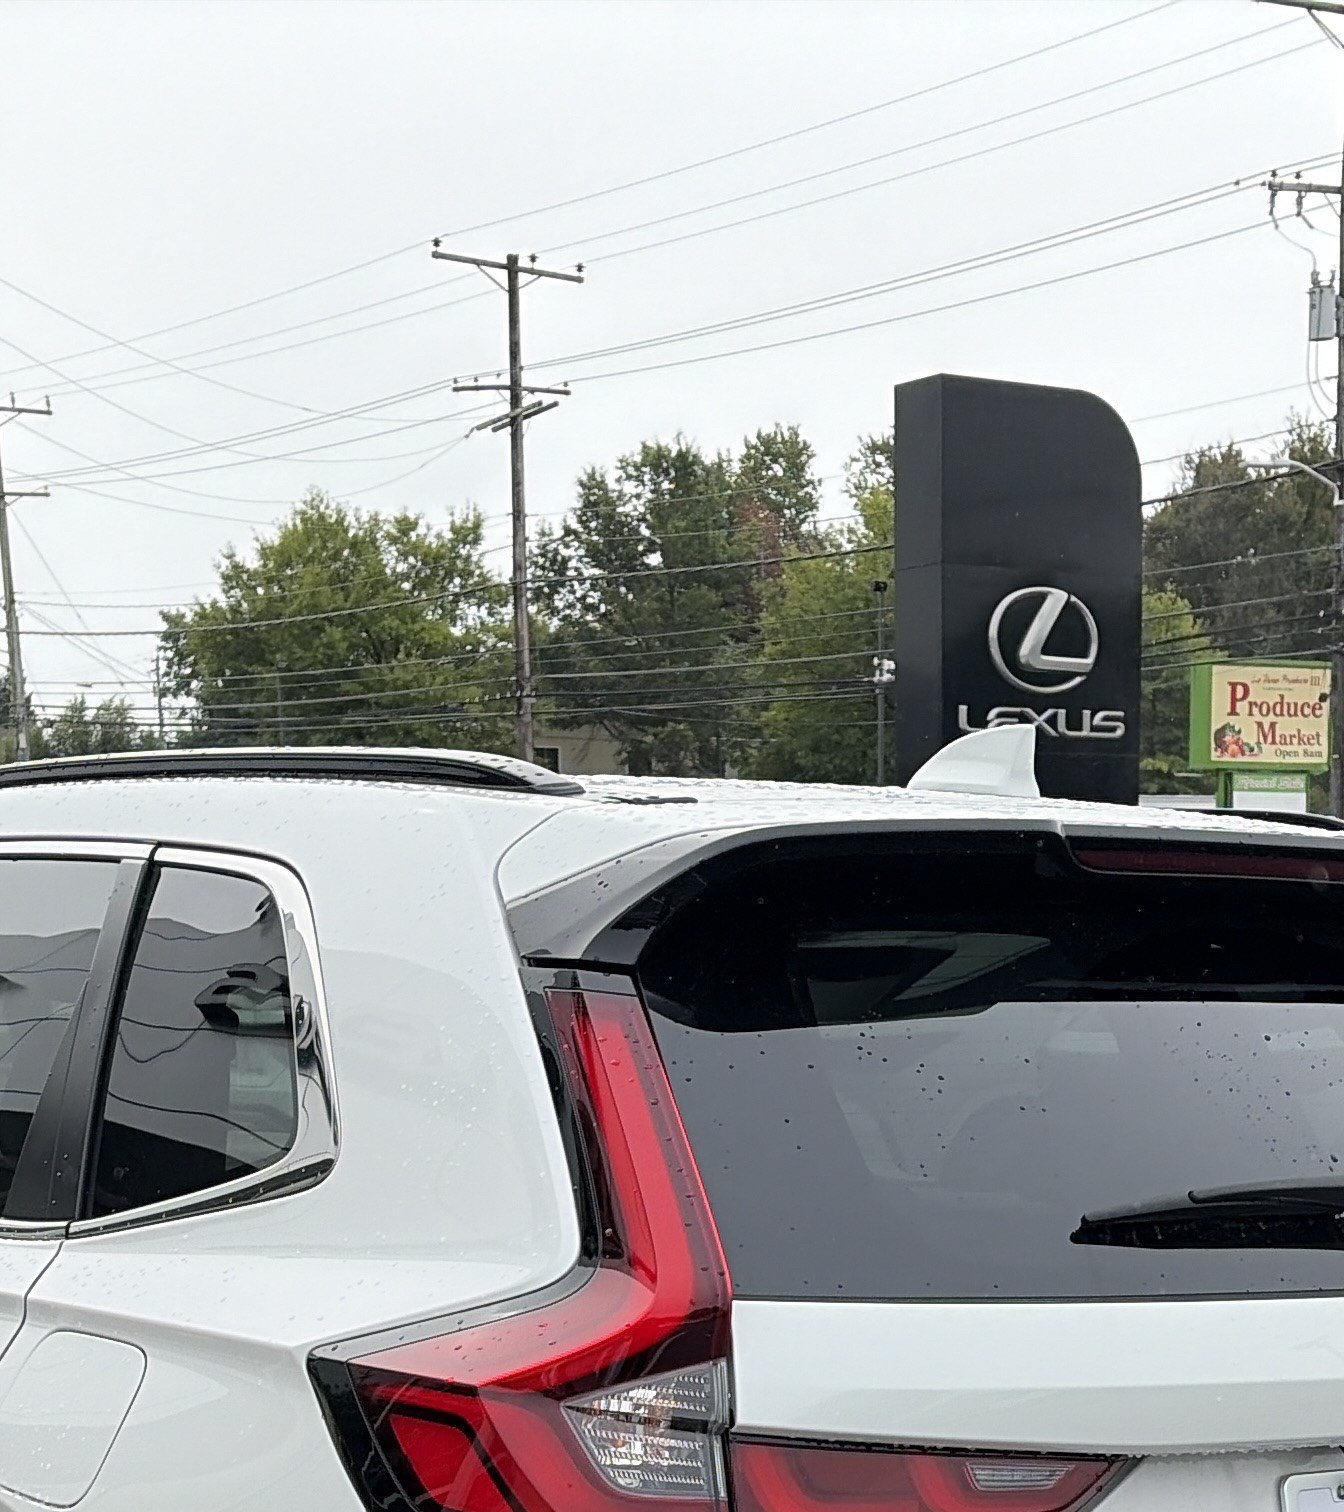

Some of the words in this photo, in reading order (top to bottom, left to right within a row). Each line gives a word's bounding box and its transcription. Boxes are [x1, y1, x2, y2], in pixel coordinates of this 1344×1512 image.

[1227, 681, 1323, 718] Produce
[958, 704, 1126, 738] LEXUS
[1255, 720, 1323, 746] Market
[1274, 748, 1300, 759] Open
[1303, 748, 1323, 758] 8am
